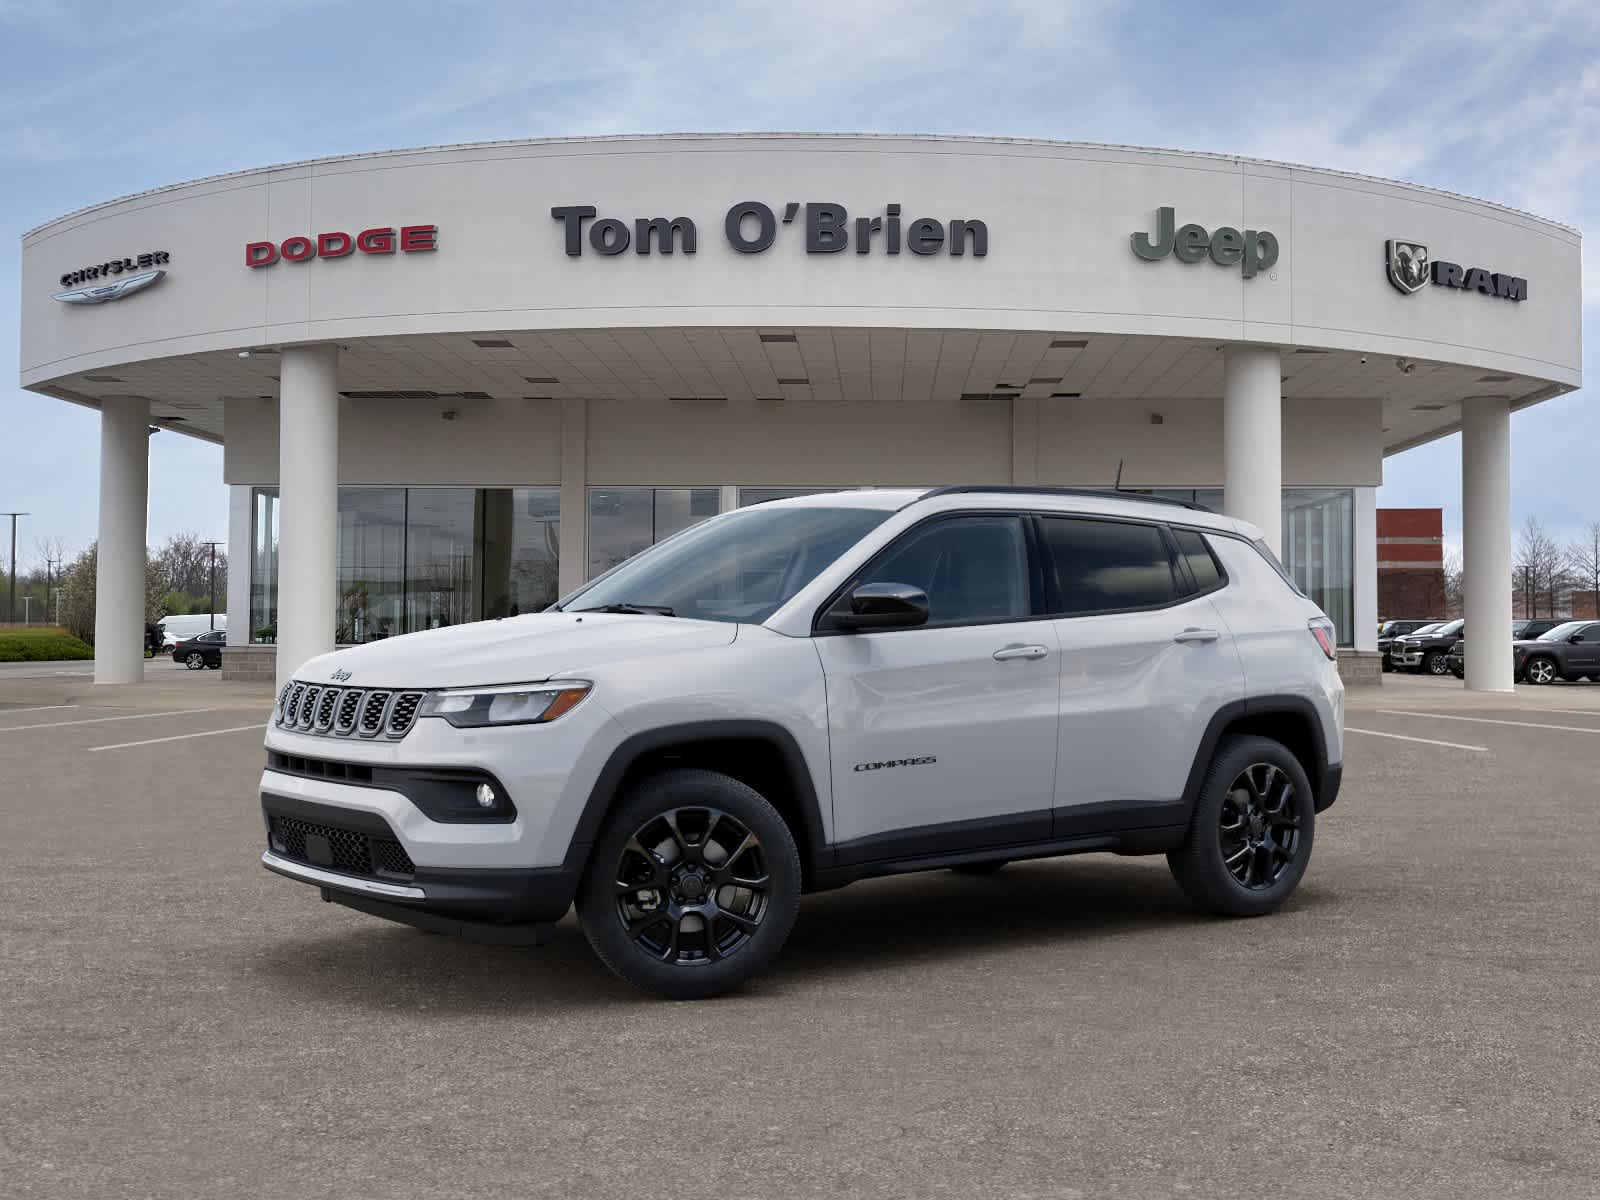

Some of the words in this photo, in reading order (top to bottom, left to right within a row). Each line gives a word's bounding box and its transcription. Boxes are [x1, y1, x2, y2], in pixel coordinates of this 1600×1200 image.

[245, 224, 438, 269] DODGE
[551, 205, 697, 256] Tom
[725, 200, 988, 256] O'Brien
[1130, 206, 1279, 279] Jeep
[59, 249, 171, 288] CHRYSLER
[1430, 260, 1528, 302] RAM
[854, 755, 937, 772] COMPASS
